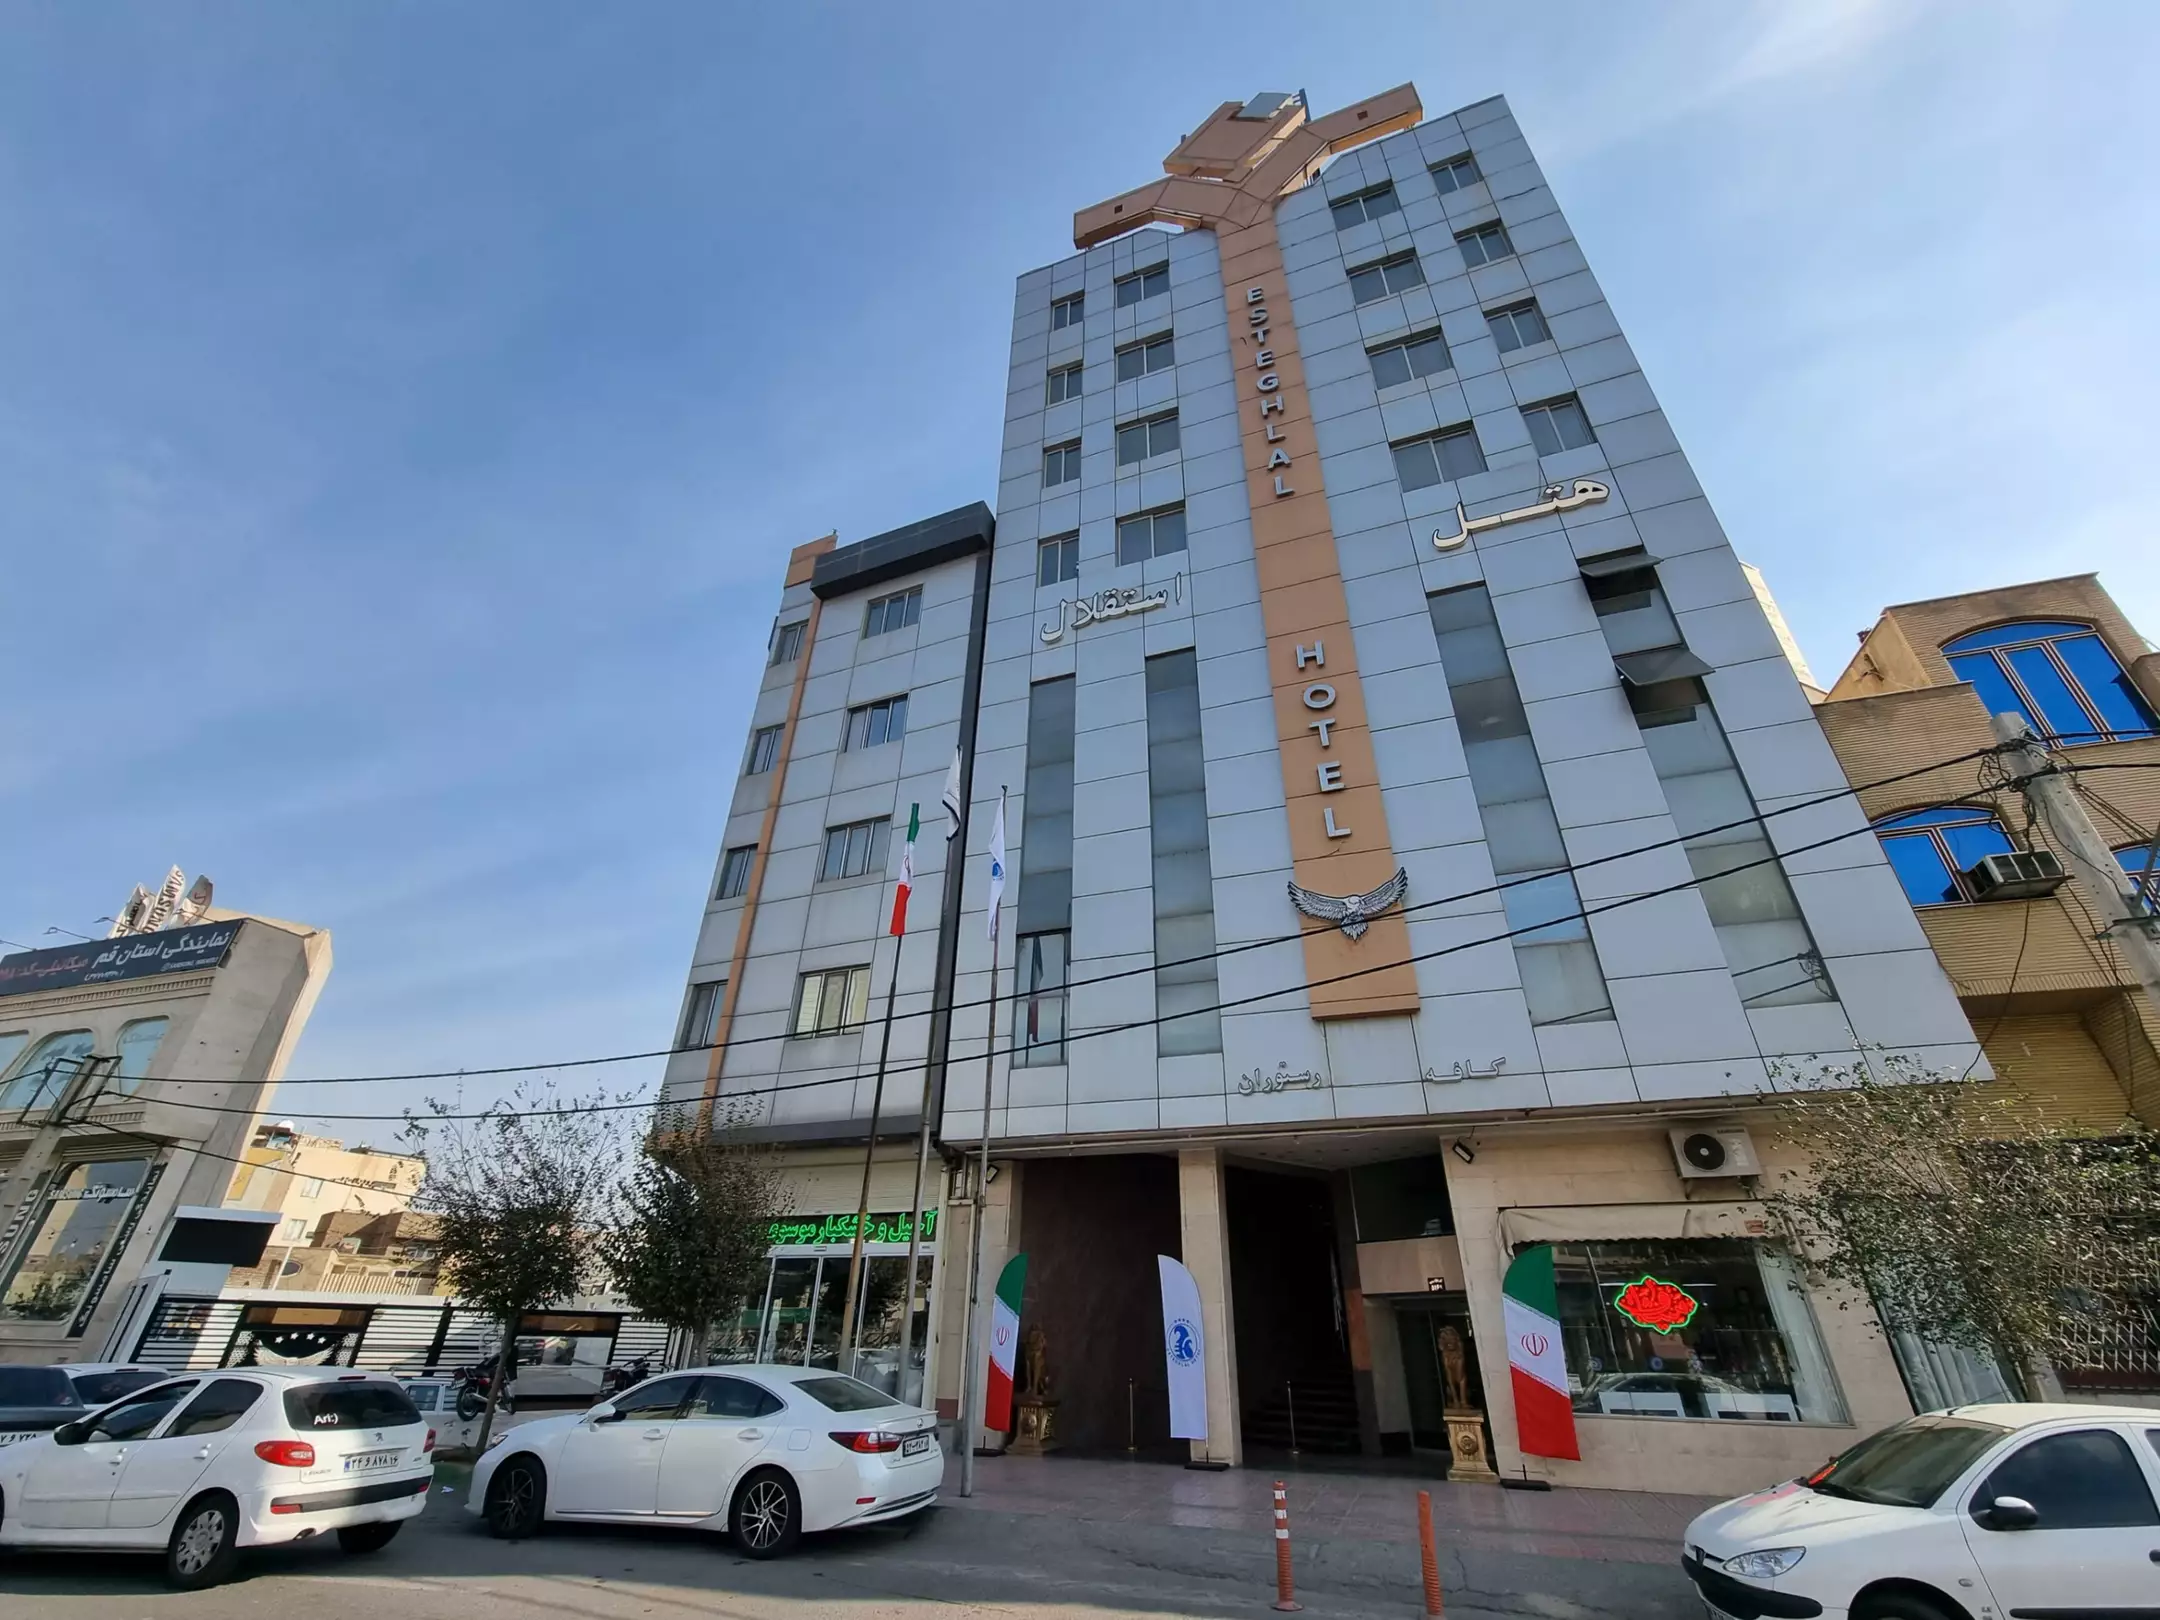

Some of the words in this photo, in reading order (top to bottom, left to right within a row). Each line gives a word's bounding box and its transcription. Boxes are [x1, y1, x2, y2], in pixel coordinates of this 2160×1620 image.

[1246, 286, 1295, 498] ESTEGHLAL
[1432, 479, 1610, 551] هتل
[1040, 571, 1182, 644] استقلال
[1296, 640, 1352, 838] HOTEL
[91, 944, 120, 969] قم
[116, 940, 164, 965] استان
[161, 931, 230, 959] نمایندگی
[1237, 1060, 1322, 1095] رستوران
[1425, 1056, 1506, 1084] کافه
